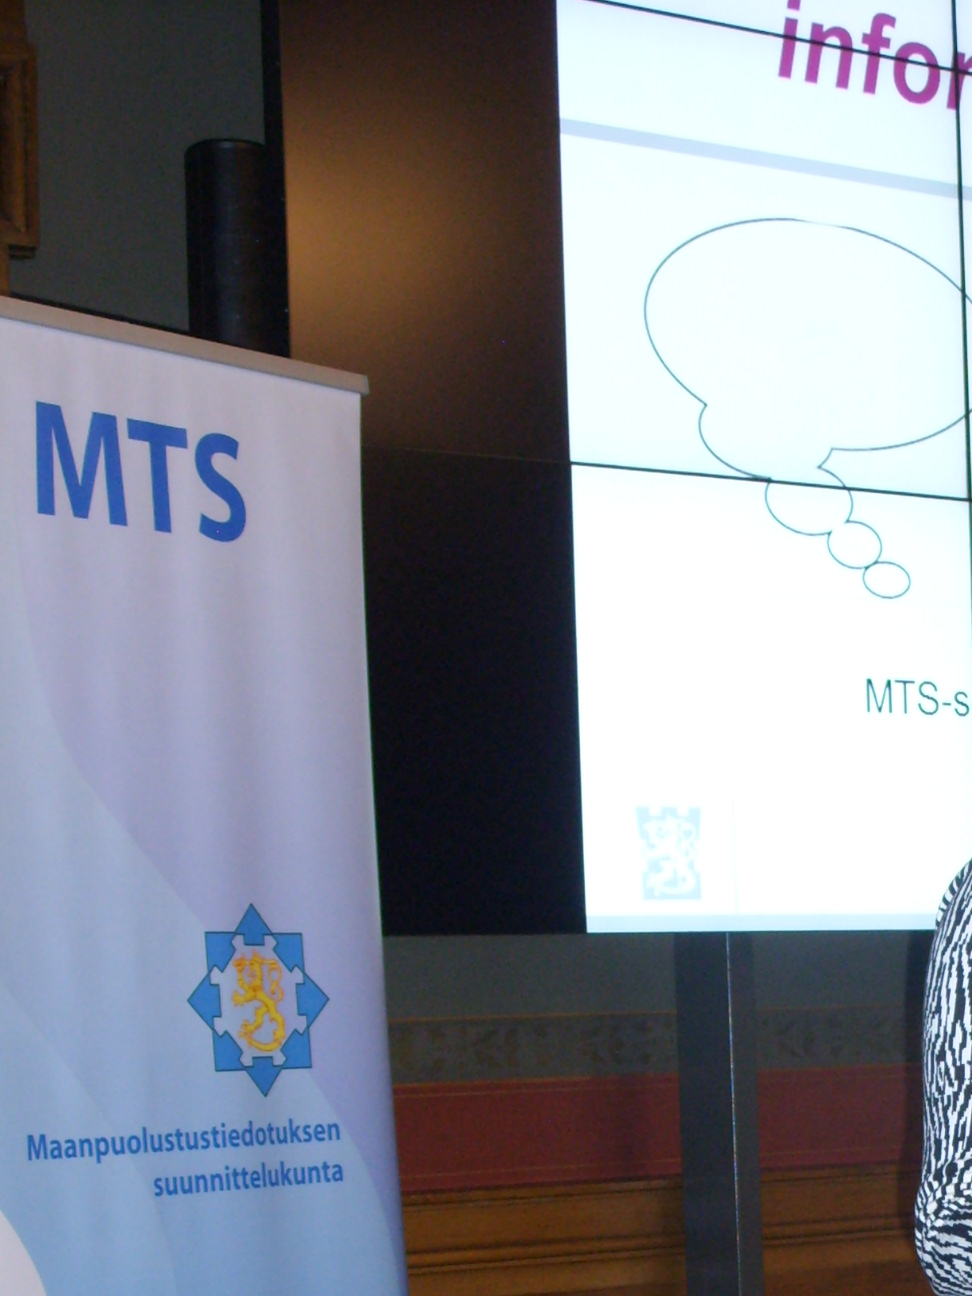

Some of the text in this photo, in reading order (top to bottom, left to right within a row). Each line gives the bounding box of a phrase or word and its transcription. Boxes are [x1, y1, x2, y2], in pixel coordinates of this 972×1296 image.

[35, 400, 248, 543] MTS
[26, 1118, 341, 1164] Maanpuolustustiedotuksen
[152, 1160, 345, 1198] suunnittelukunta
